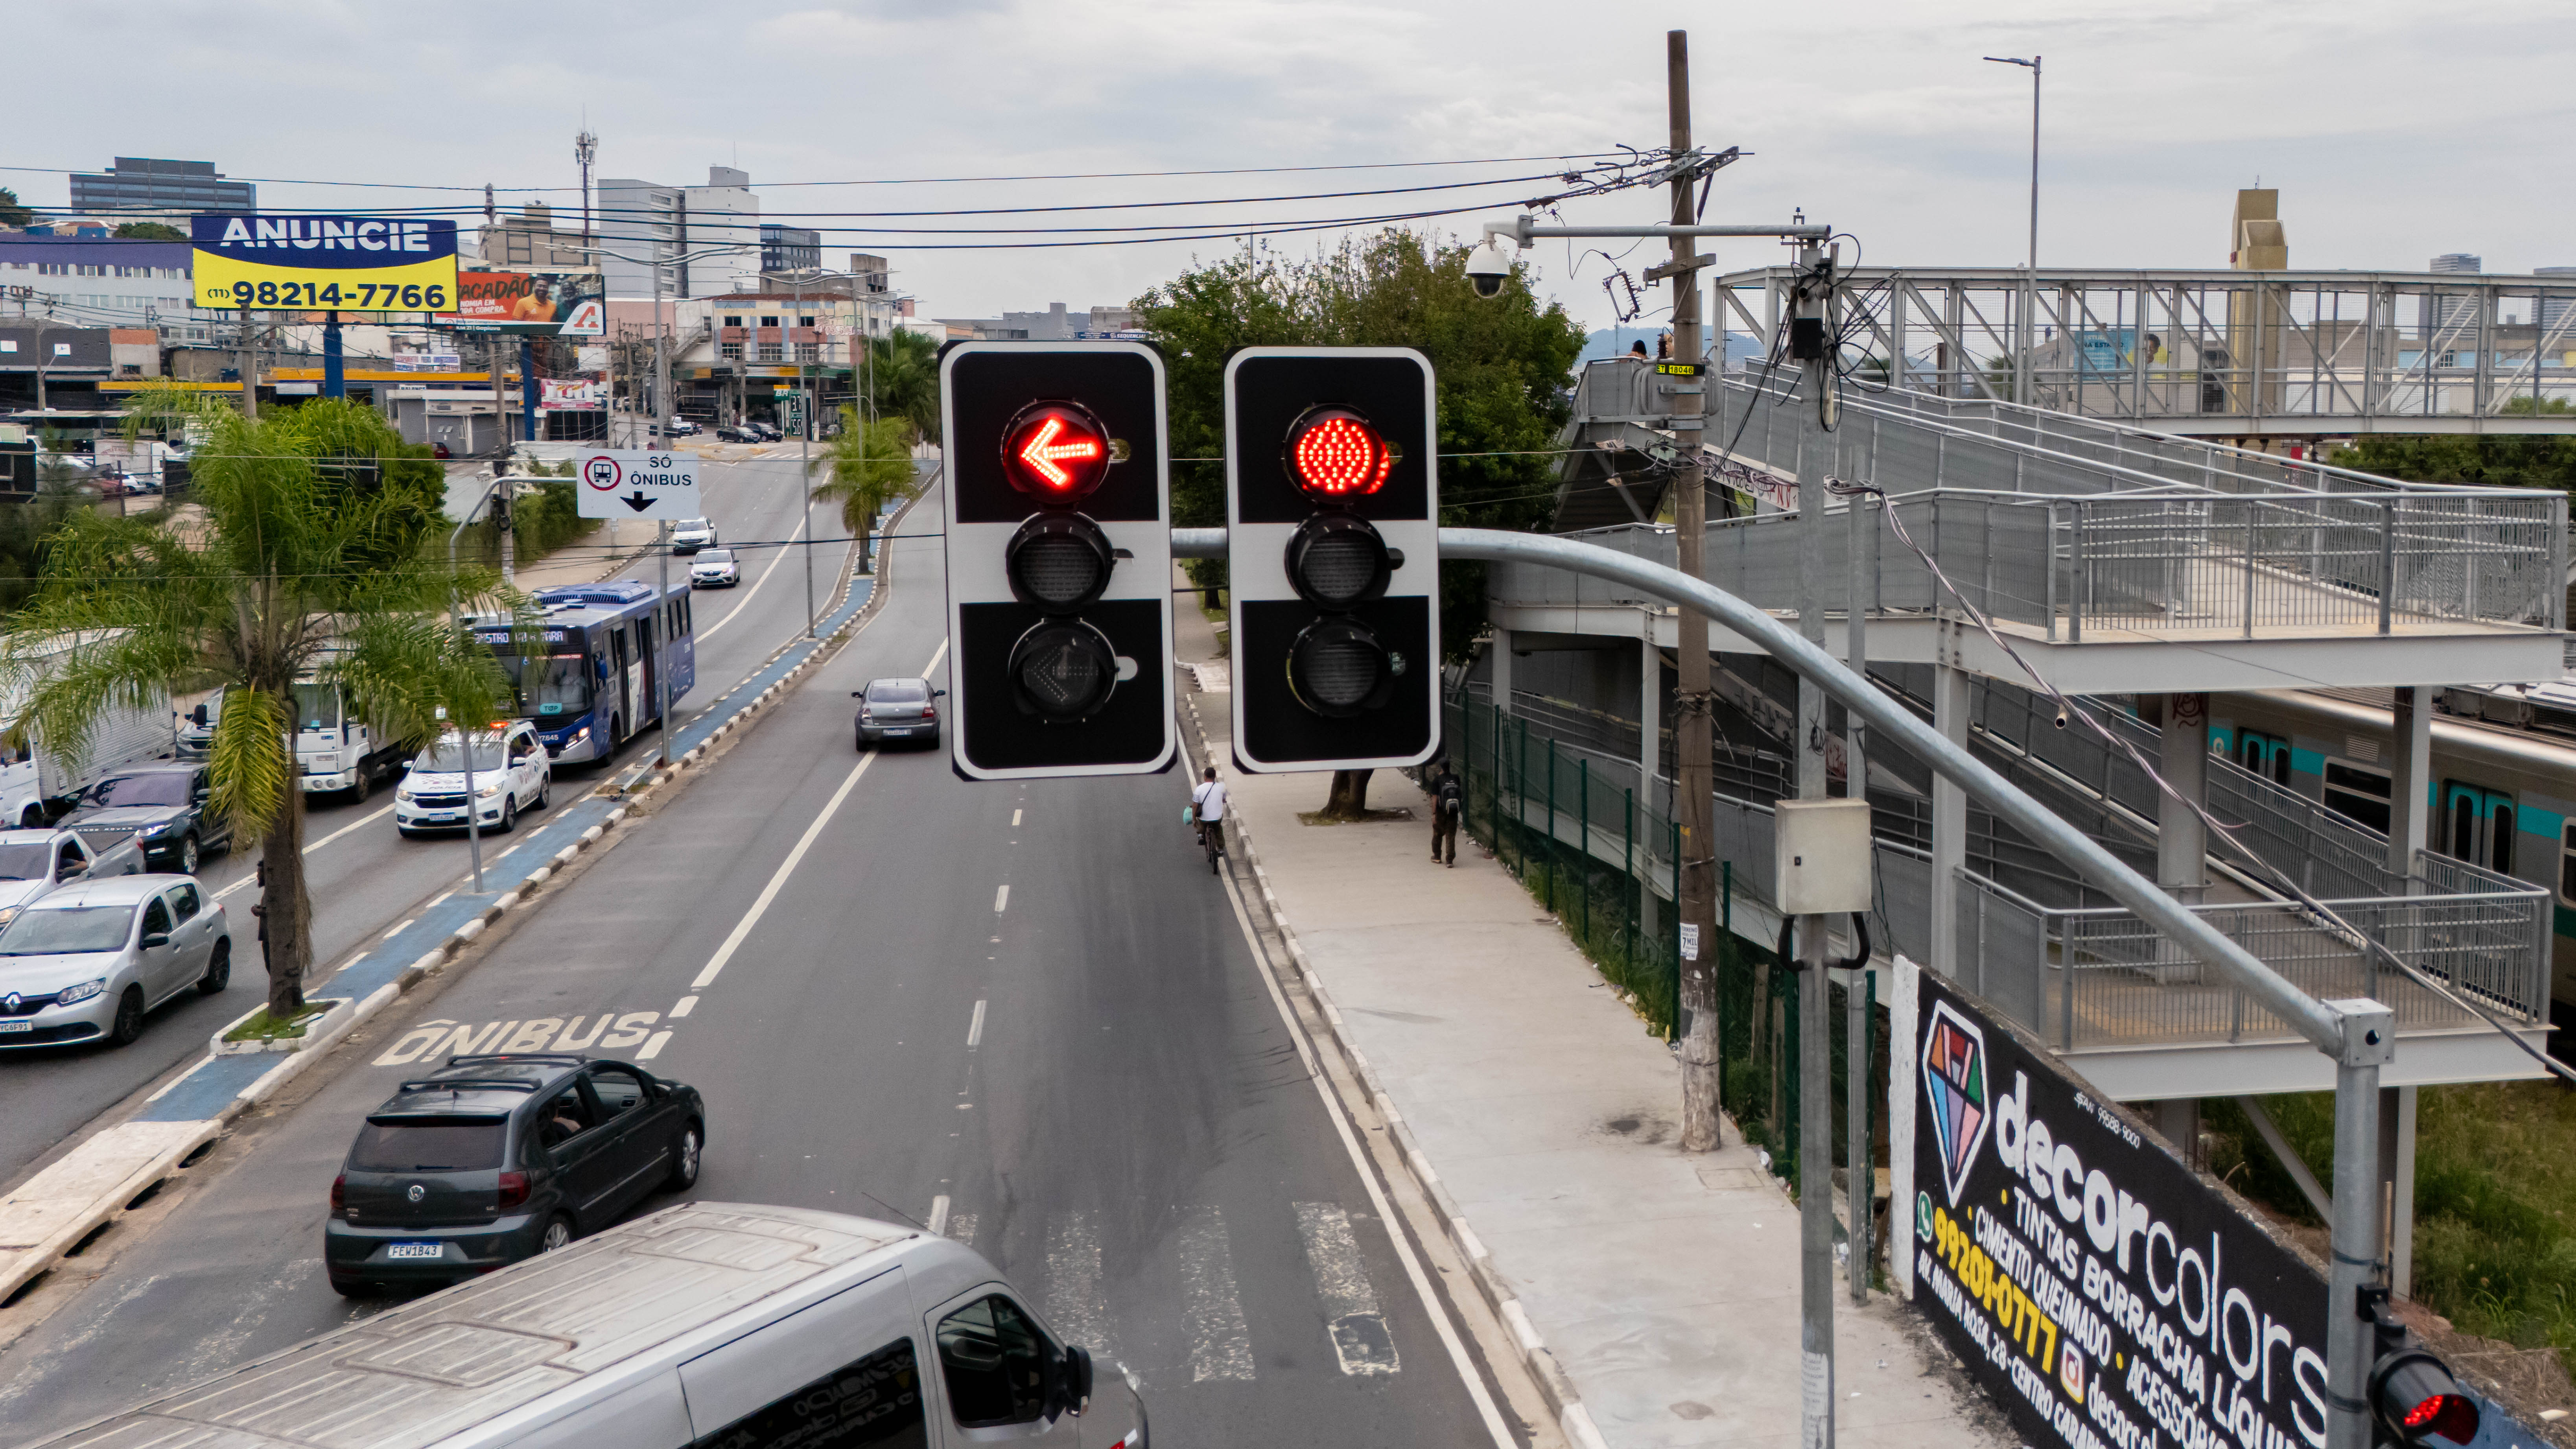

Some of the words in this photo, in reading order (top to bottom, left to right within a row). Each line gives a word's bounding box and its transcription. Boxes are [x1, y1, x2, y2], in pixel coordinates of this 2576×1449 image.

[220, 218, 430, 251] ANUNCIE
[208, 288, 230, 299] (11)
[233, 280, 446, 308] 98214-7766
[650, 454, 672, 468] SÓ
[630, 471, 692, 486] ÔNIBUS
[518, 785, 540, 805] POLÍCIA
[1682, 937, 1686, 948] 7
[371, 1010, 661, 1066] ÔNIBUS
[392, 1246, 437, 1256] FEW1B43
[1996, 1071, 2327, 1448] decorcolors
[1935, 1206, 2057, 1375] 99201-0777
[1975, 1205, 2031, 1289] CIMENTO
[2032, 1263, 2111, 1366] QUEIMADO
[2014, 1186, 2080, 1281] TINTAS
[2083, 1255, 2205, 1405] BORRACHA
[2212, 1372, 2296, 1449] LÍQUI
[1918, 1249, 1932, 1282] AV.
[1931, 1268, 1963, 1322] MARIA
[2053, 1401, 2107, 1449] CARAP
